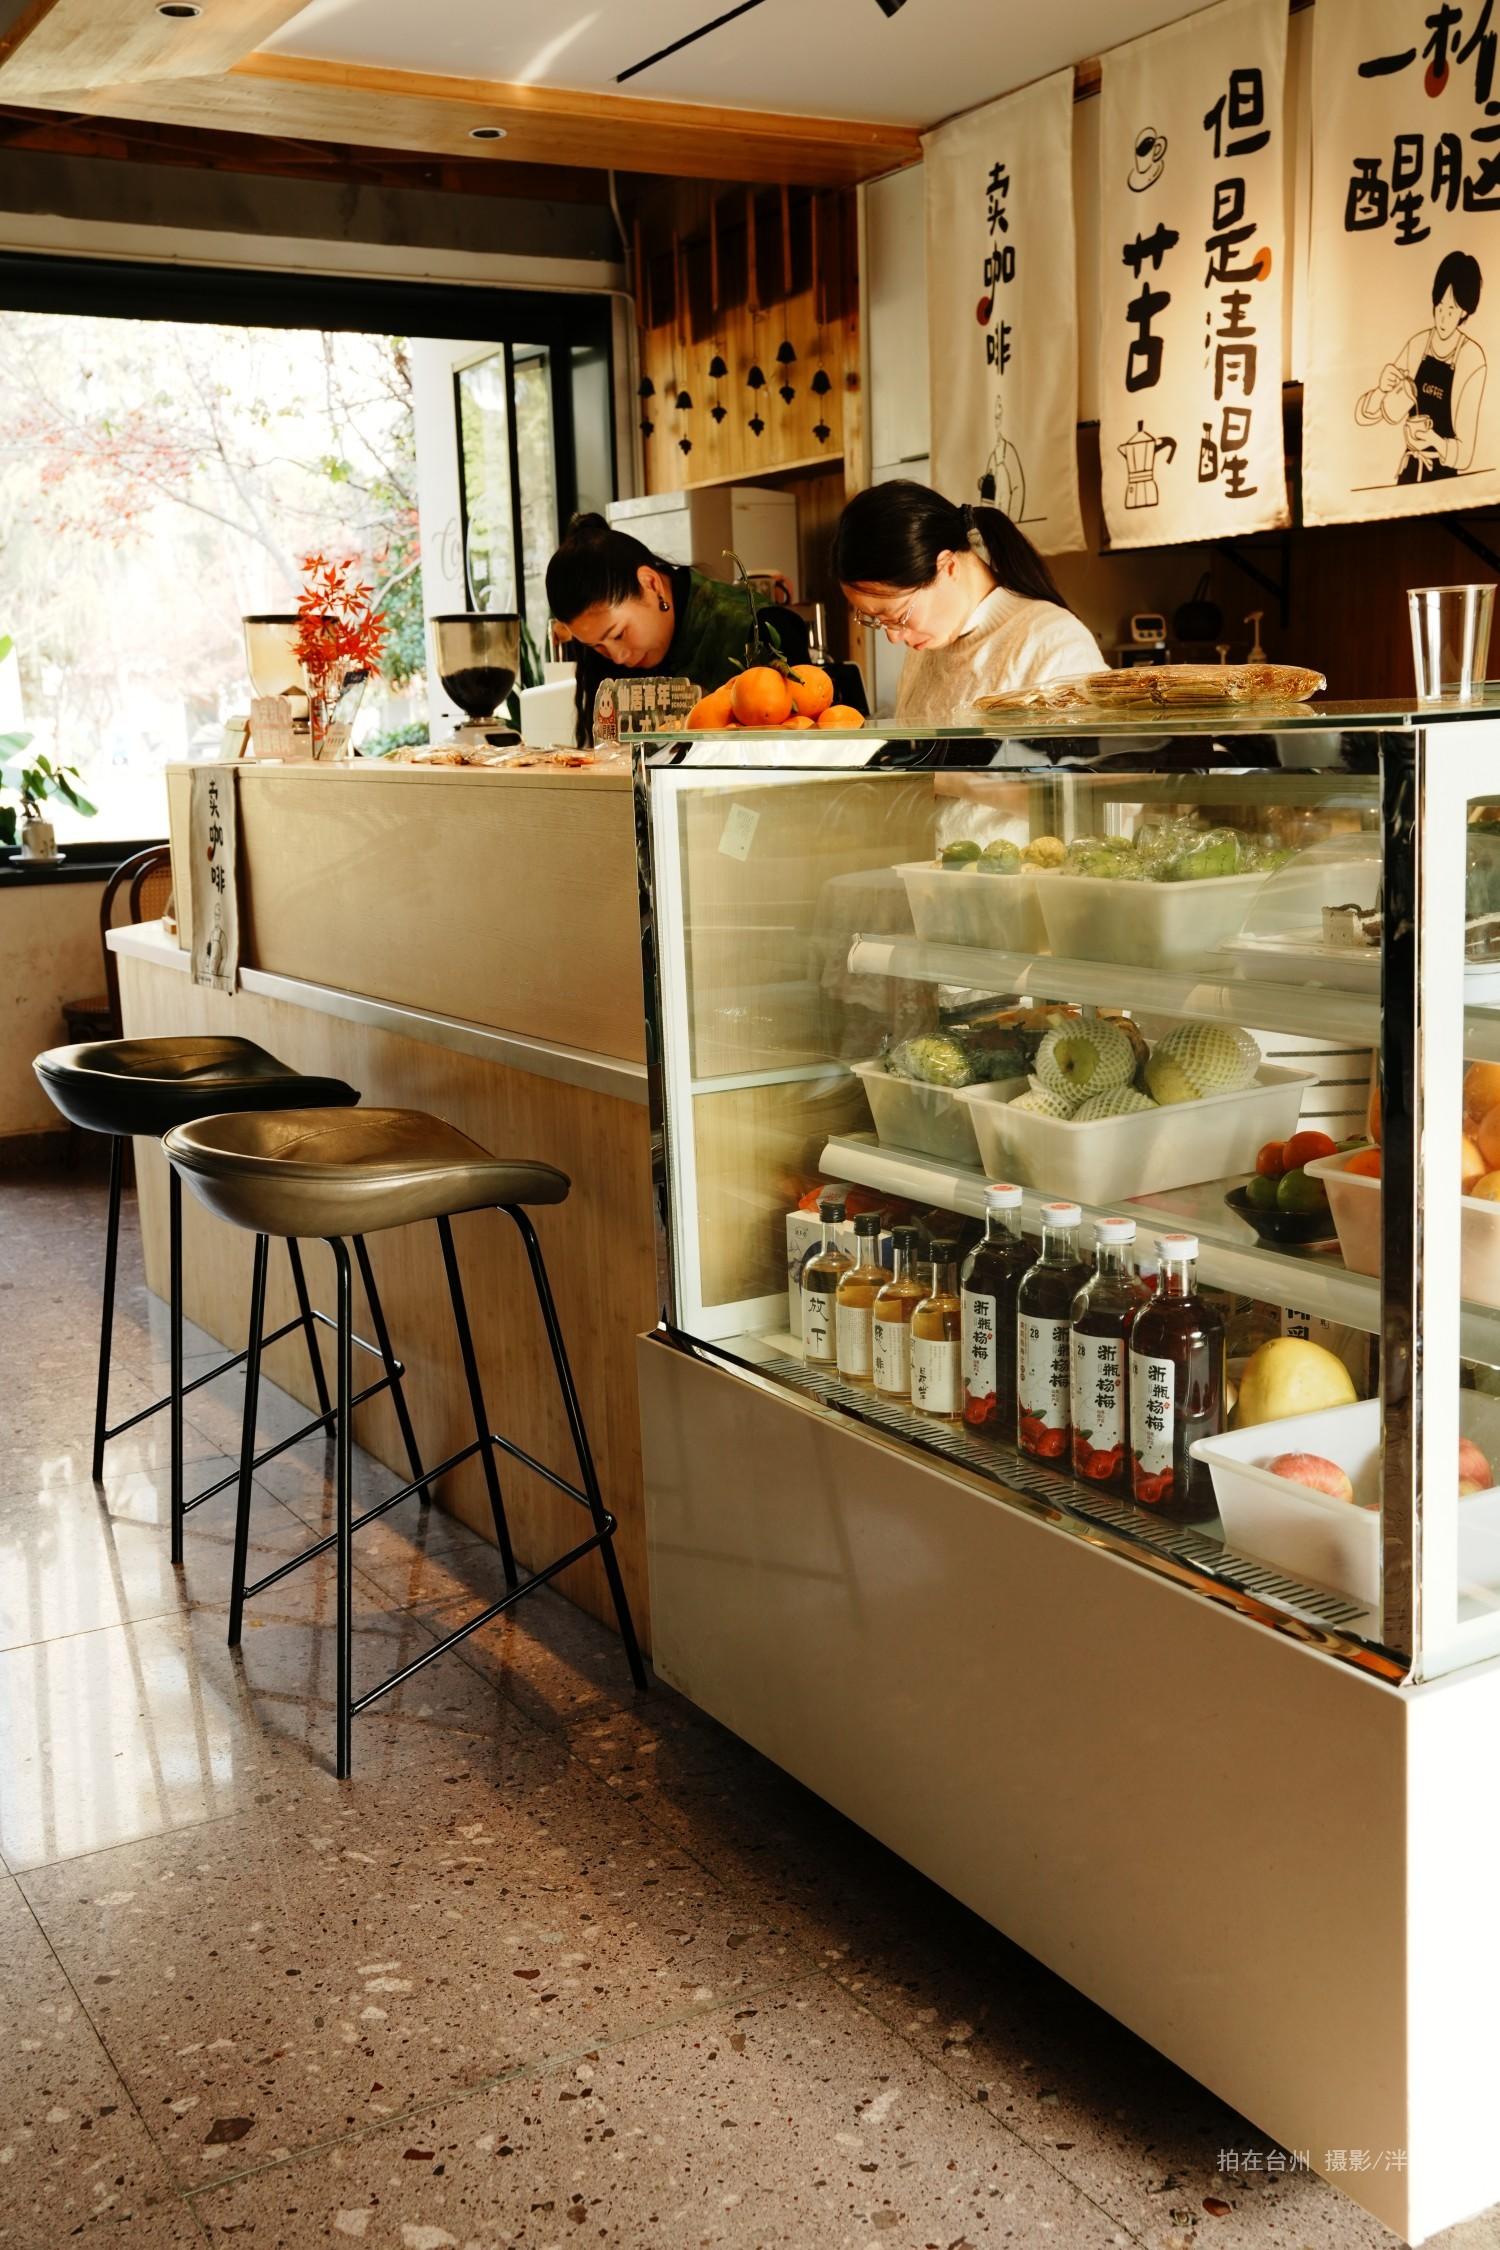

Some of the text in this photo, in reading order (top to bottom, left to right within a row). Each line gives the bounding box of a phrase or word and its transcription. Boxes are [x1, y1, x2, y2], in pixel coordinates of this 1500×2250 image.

[984, 161, 1016, 376] 卖咖啡
[1198, 67, 1271, 499] 但是清醒
[1122, 223, 1180, 394] 苦
[208, 781, 226, 895] 卖咖啡
[808, 1296, 830, 1353] 放下
[971, 1299, 993, 1360] 浙瓶杨梅
[1029, 1327, 1040, 1339] 28
[1094, 1344, 1121, 1409] 浙瓶杨梅
[1144, 1364, 1170, 1432] 浙瓶杨梅
